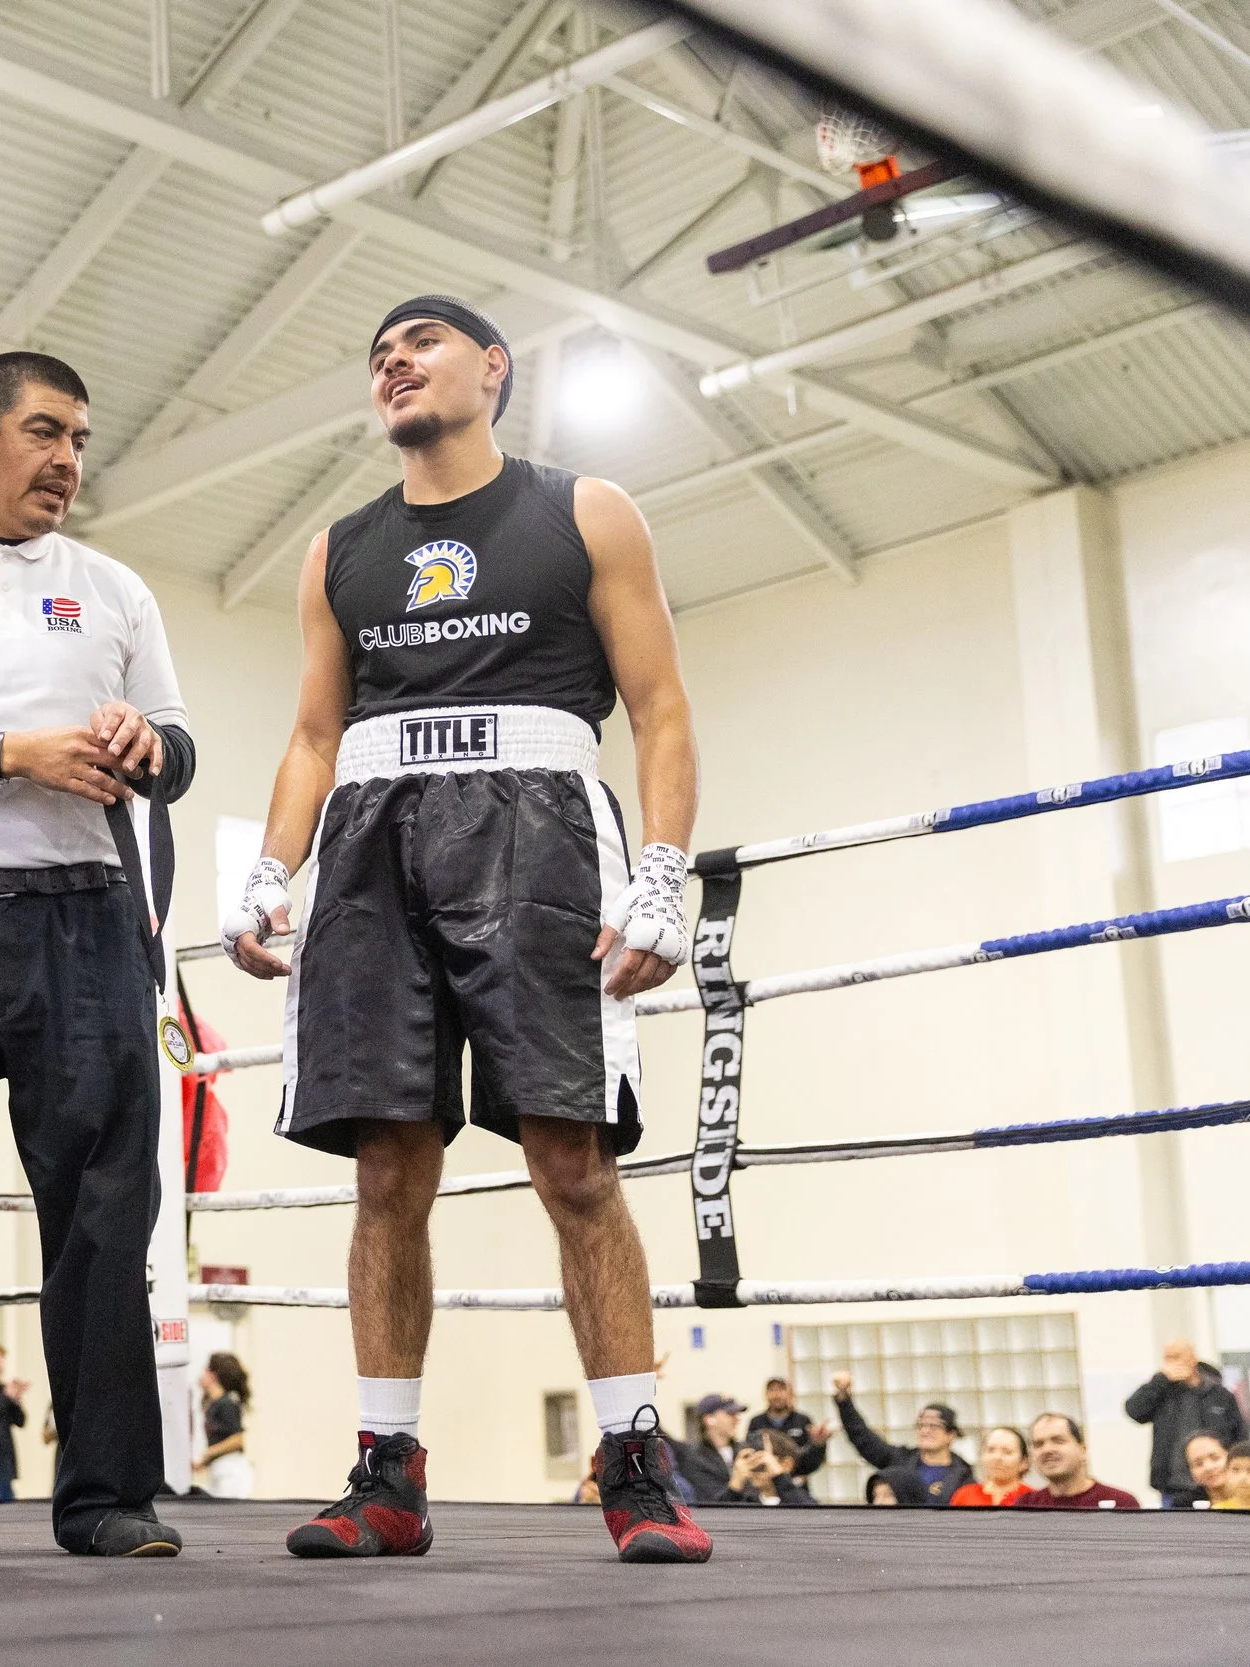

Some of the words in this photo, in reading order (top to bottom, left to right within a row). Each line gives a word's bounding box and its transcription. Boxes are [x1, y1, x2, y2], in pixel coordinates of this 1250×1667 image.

[46, 617, 82, 628] USA
[47, 626, 82, 634] BOXING
[358, 612, 531, 651] CLUBBOXING
[406, 719, 487, 756] TITLE
[411, 752, 484, 761] BOXING
[692, 915, 743, 1240] RINGSIDE
